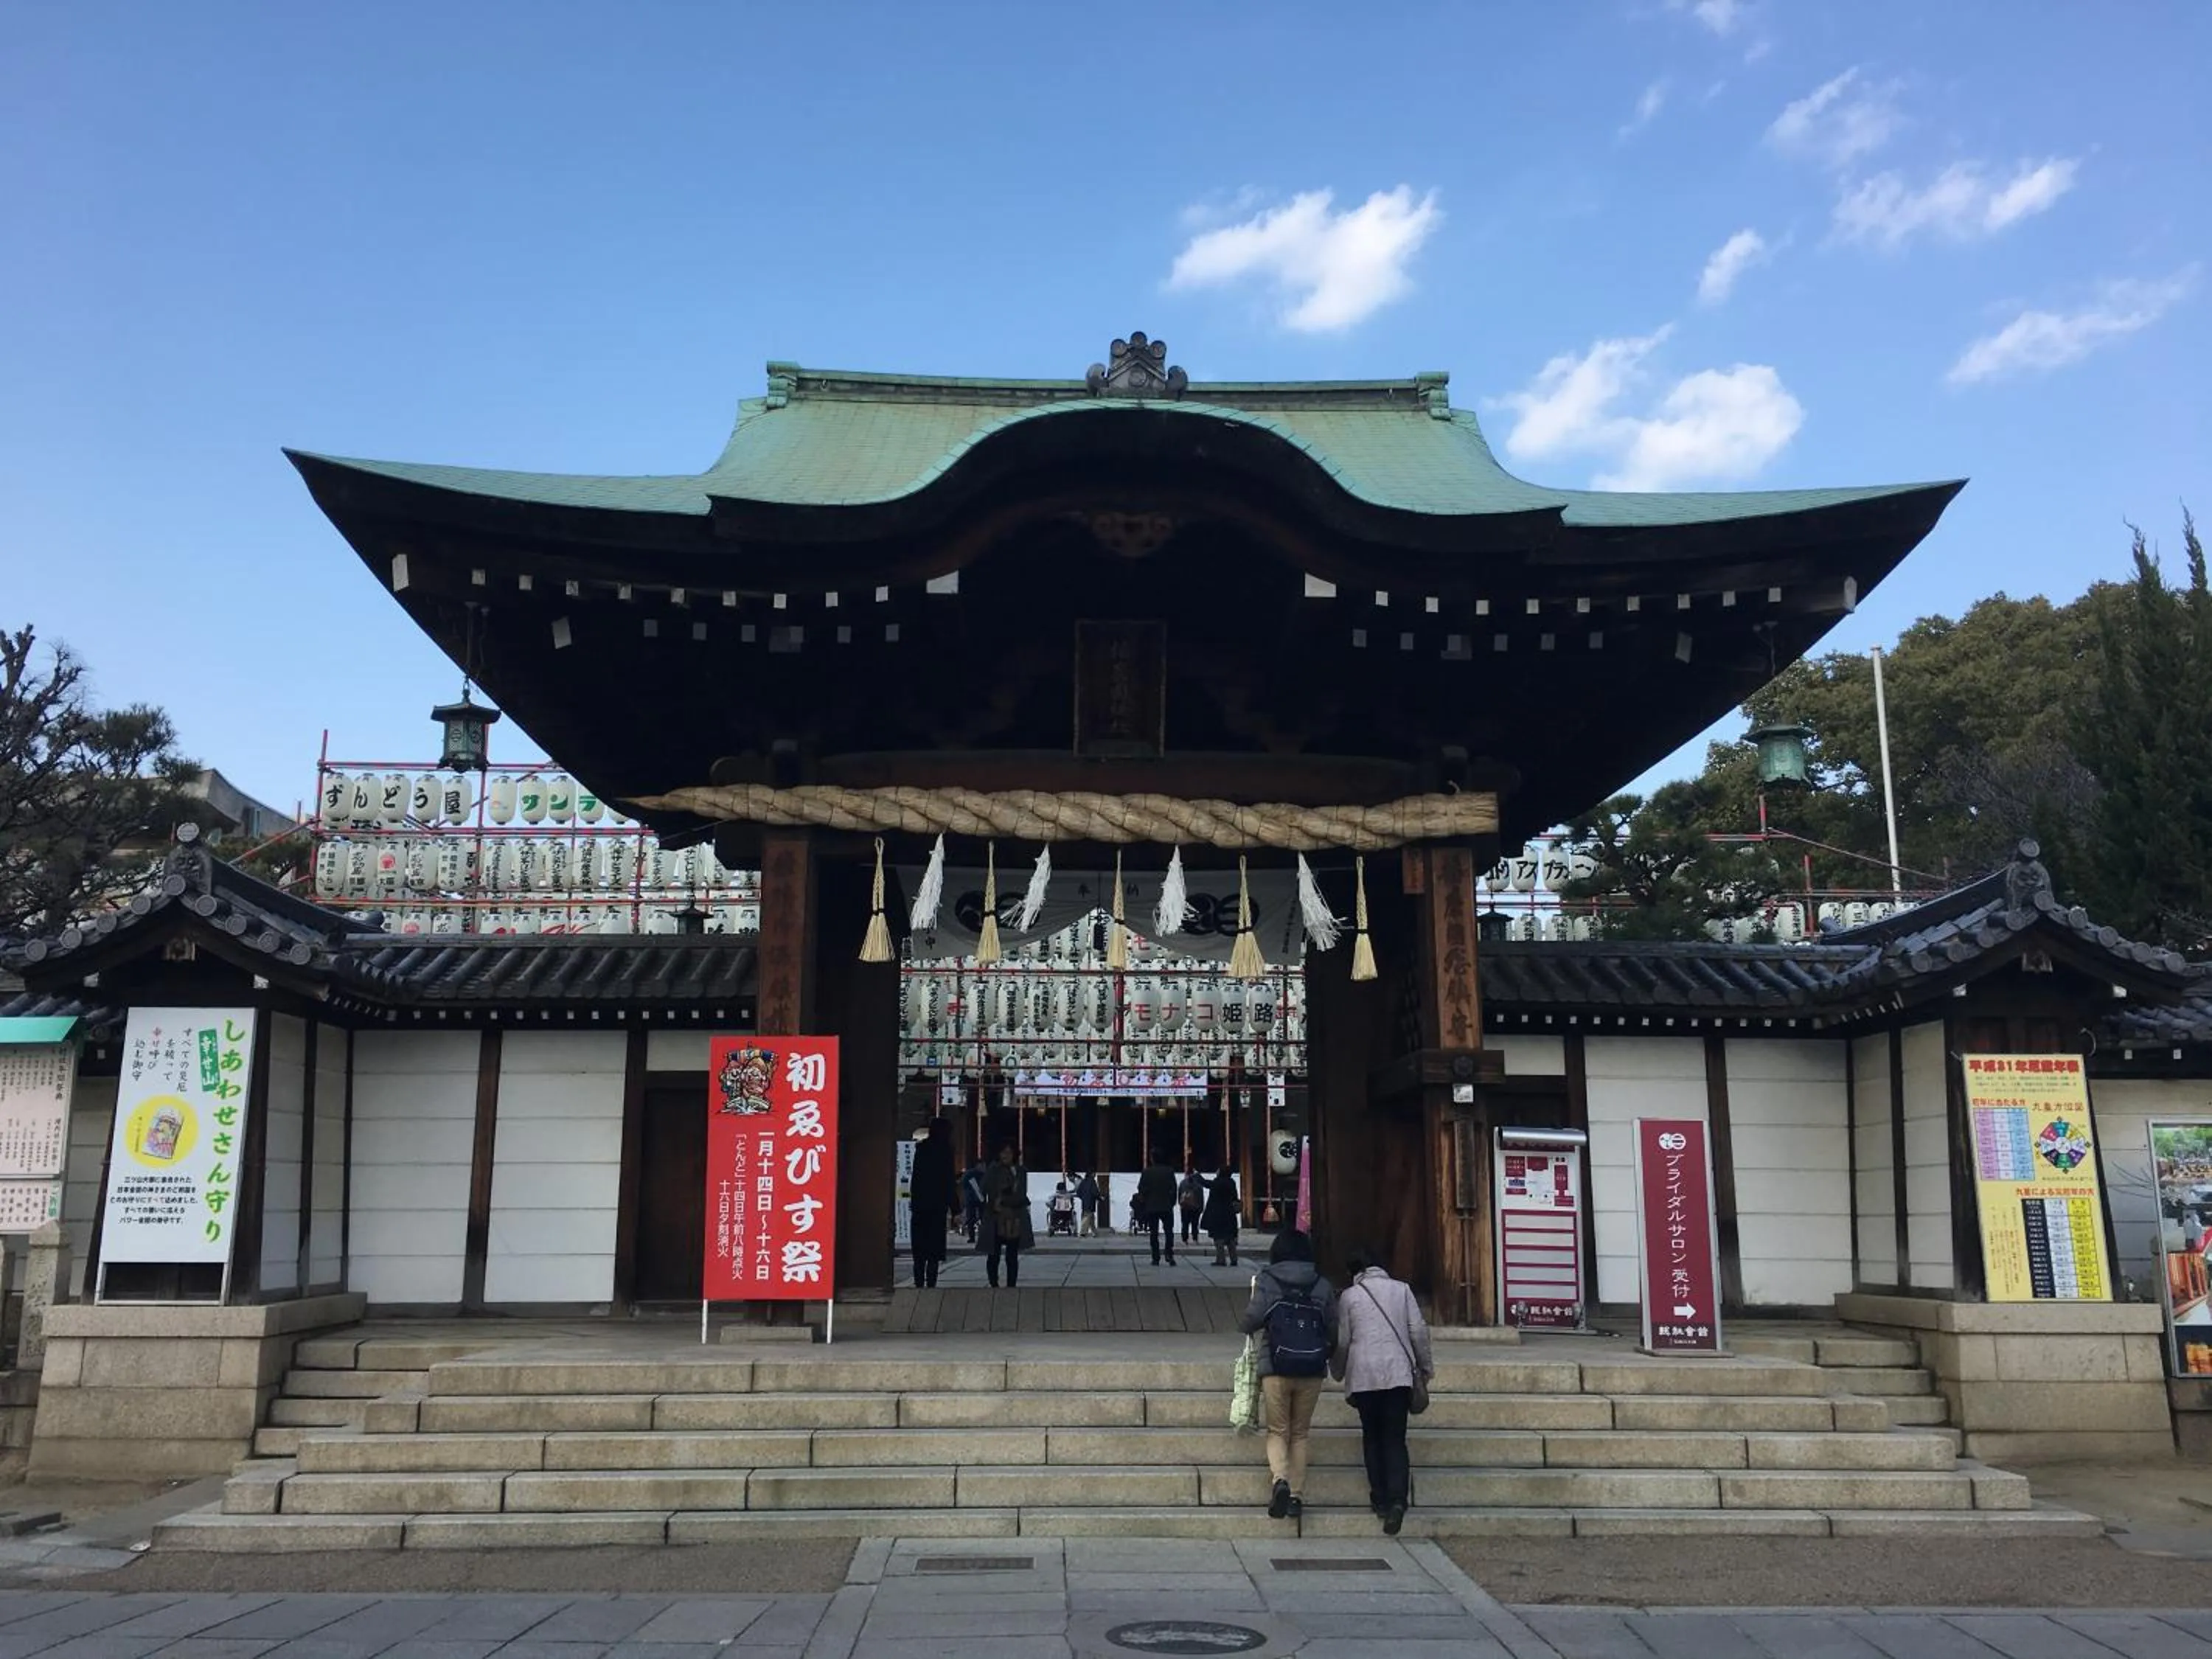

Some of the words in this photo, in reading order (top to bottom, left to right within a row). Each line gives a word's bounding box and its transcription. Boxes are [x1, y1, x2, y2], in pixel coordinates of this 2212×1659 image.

[326, 784, 461, 815] ずんどう屋
[1135, 1002, 1273, 1023] モナコ姫路
[204, 1019, 246, 1243] しあわせさん守り
